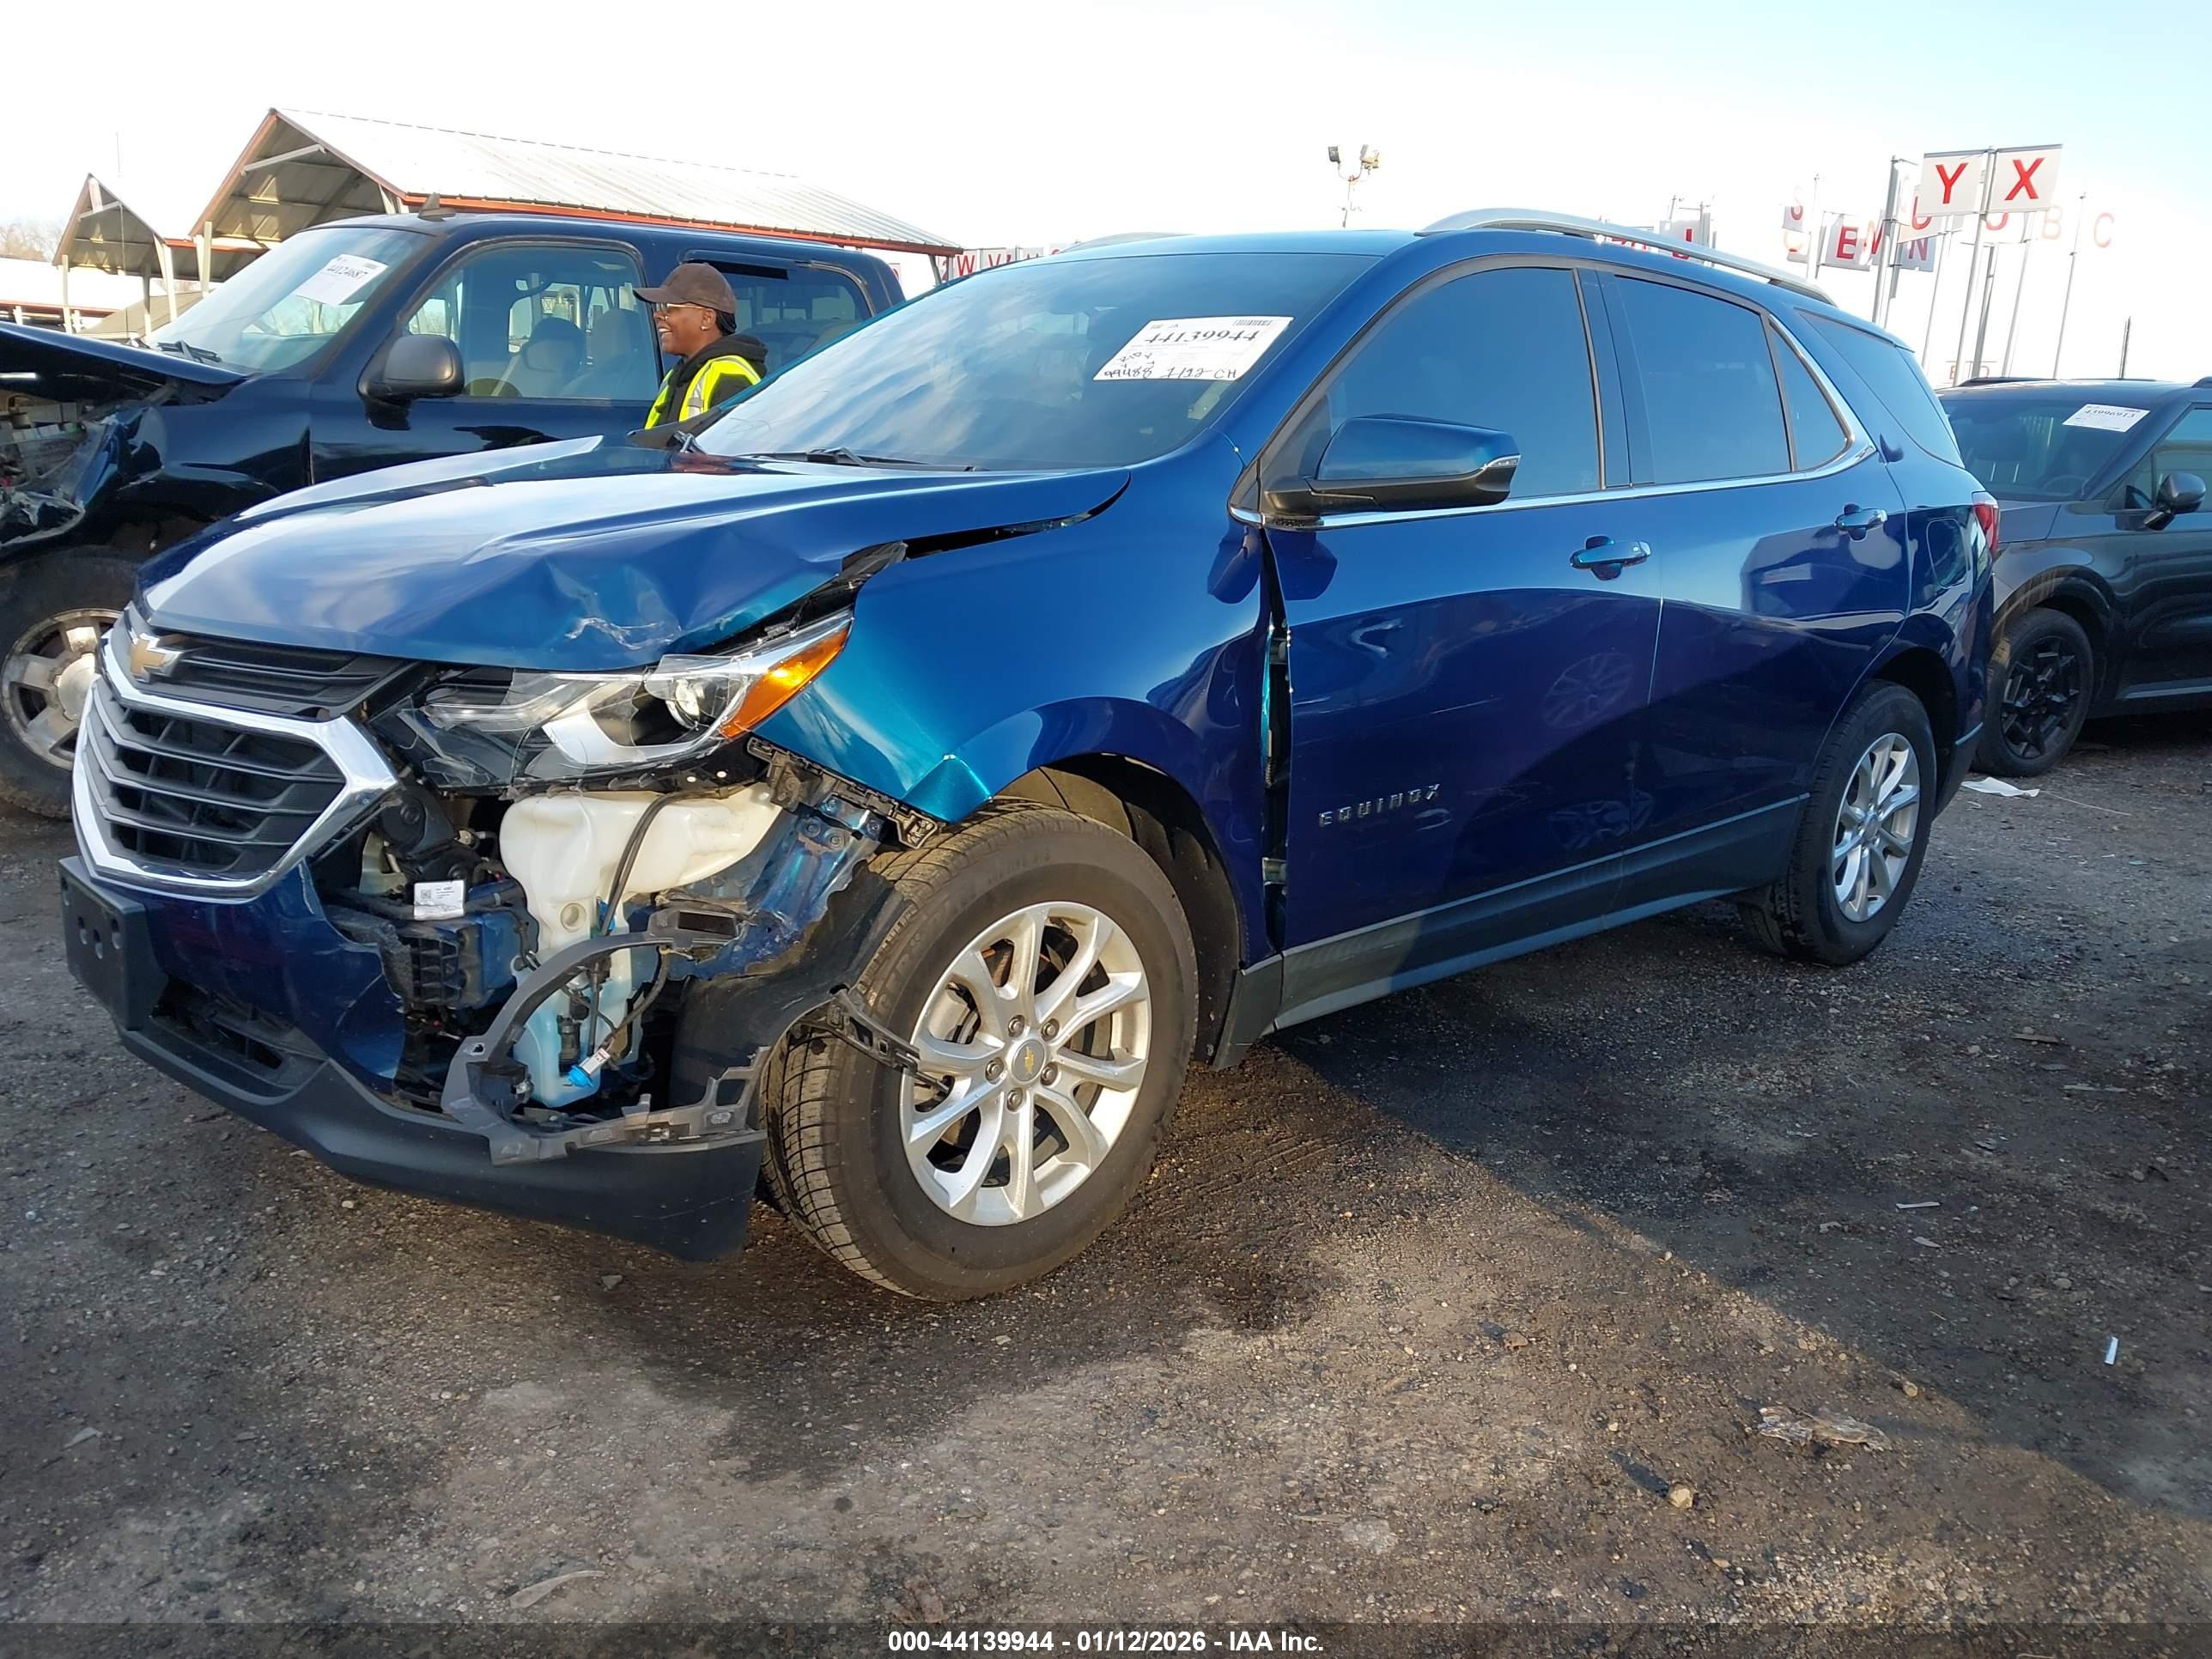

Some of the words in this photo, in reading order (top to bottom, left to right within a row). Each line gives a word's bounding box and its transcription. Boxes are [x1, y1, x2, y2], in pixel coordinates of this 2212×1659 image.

[1936, 161, 1970, 205] Y
[2004, 156, 2045, 202] X
[1836, 225, 1859, 260] E
[956, 254, 976, 277] W
[1144, 329, 1261, 344] 44139944
[1319, 783, 1441, 827] EQUINOX
